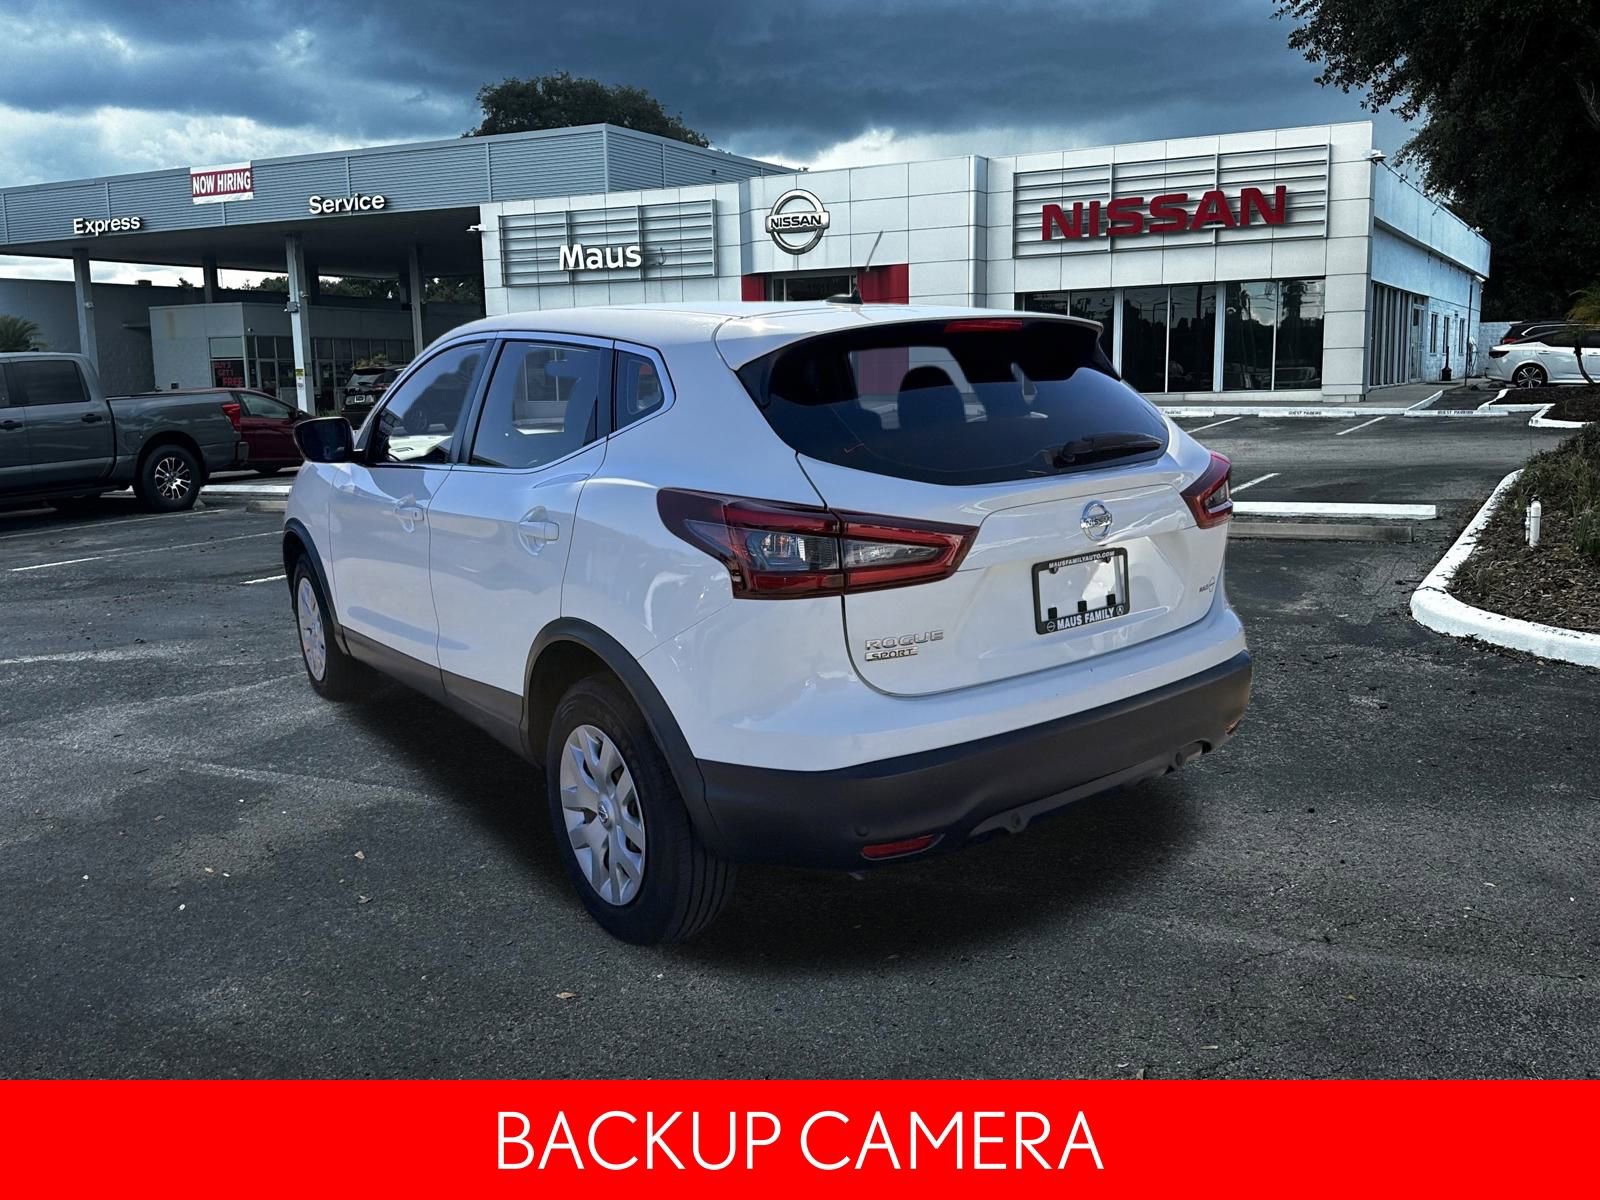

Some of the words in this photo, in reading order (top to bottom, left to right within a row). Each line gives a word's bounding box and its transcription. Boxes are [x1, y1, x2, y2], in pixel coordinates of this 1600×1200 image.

[192, 174, 216, 196] NOW
[217, 170, 252, 193] HIRING
[309, 194, 386, 215] Service
[1041, 185, 1287, 242] NISSAN
[73, 215, 142, 236] Express
[770, 214, 822, 228] NISSAN
[559, 244, 642, 271] Maus
[1048, 550, 1116, 568] MAUSFAMILYAUTO.COM
[1057, 614, 1083, 630] MAUS
[1084, 607, 1115, 624] FAMILY
[864, 629, 944, 650] ROGUE
[871, 648, 914, 660] SPORT
